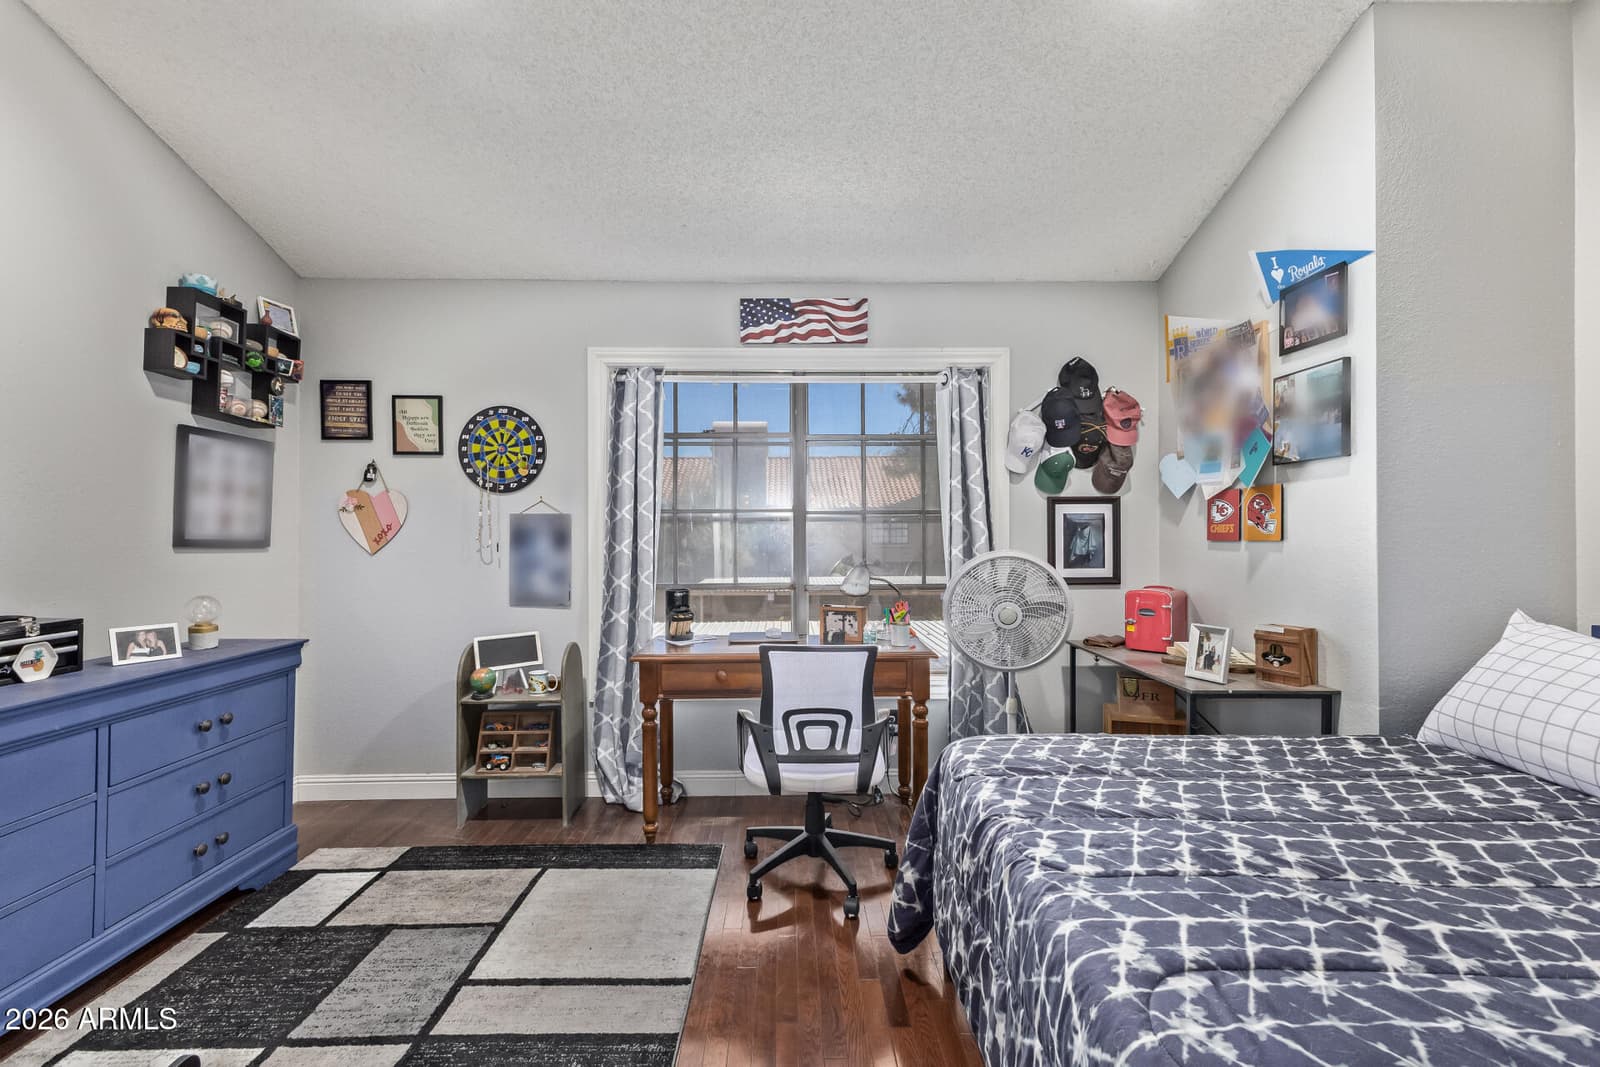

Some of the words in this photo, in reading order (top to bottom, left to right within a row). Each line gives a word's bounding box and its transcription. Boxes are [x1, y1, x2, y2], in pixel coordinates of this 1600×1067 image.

[1270, 256, 1279, 269] I
[1288, 255, 1326, 282] Royals
[1210, 523, 1235, 533] CHIEFS
